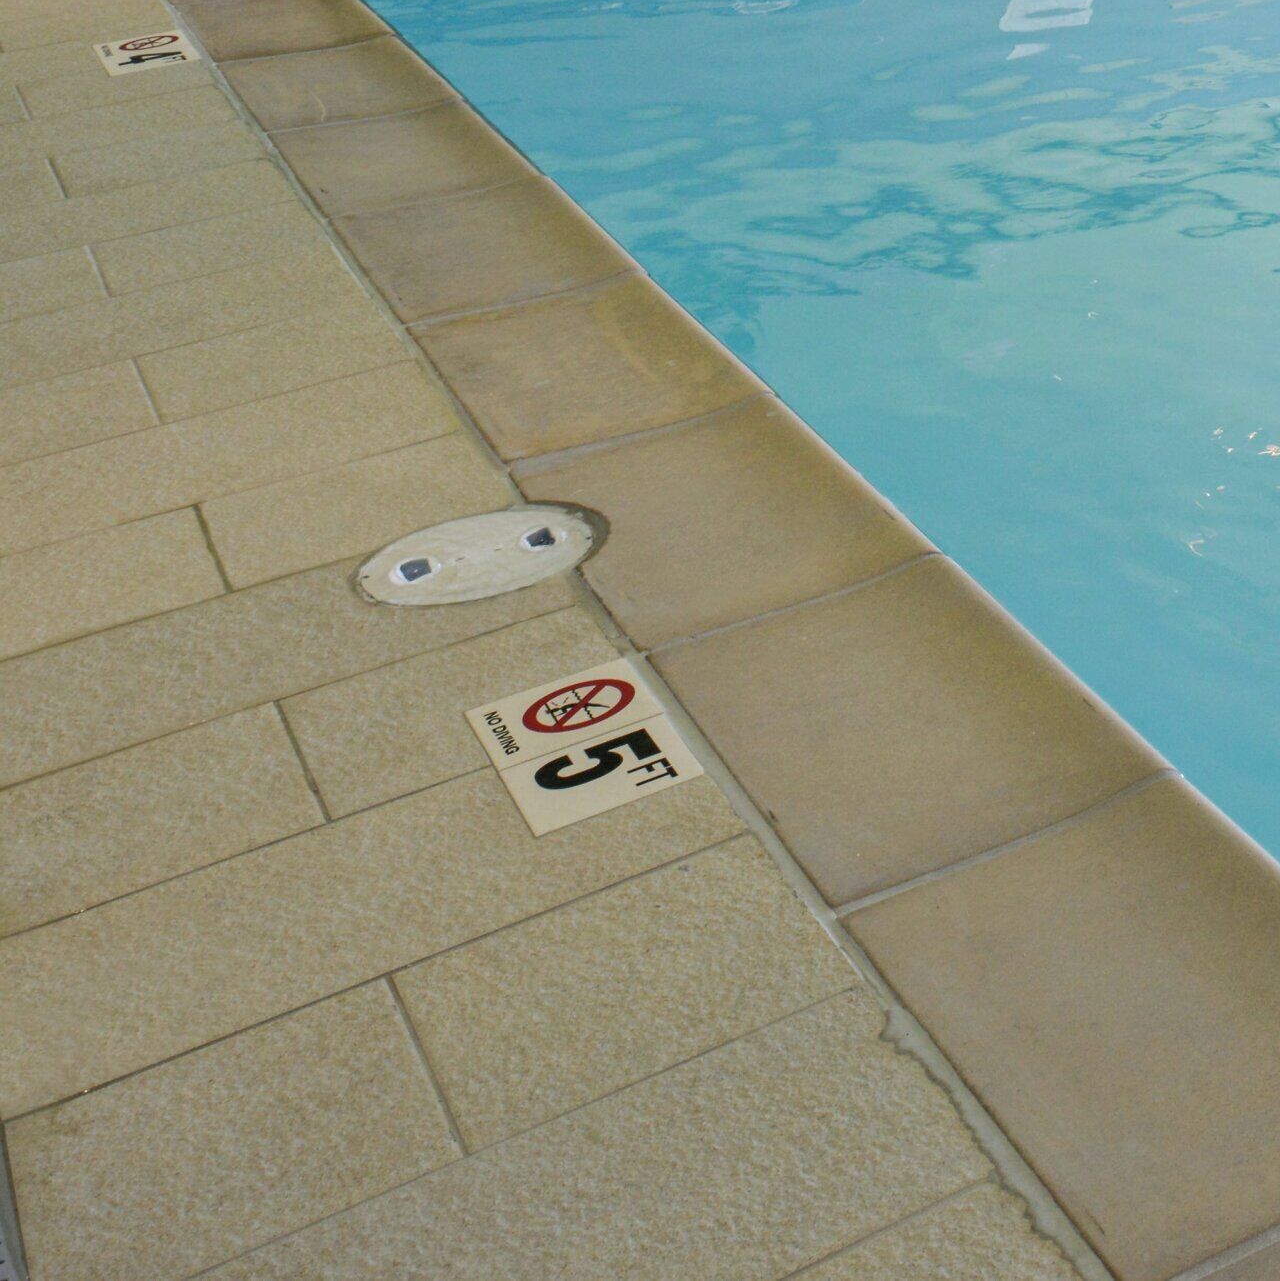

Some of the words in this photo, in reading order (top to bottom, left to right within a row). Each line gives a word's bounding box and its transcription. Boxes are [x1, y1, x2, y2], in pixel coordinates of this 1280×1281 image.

[118, 51, 183, 66] 4
[483, 710, 503, 726] NO
[491, 724, 520, 756] DIVING
[534, 728, 662, 790] 5
[627, 756, 679, 787] FT
